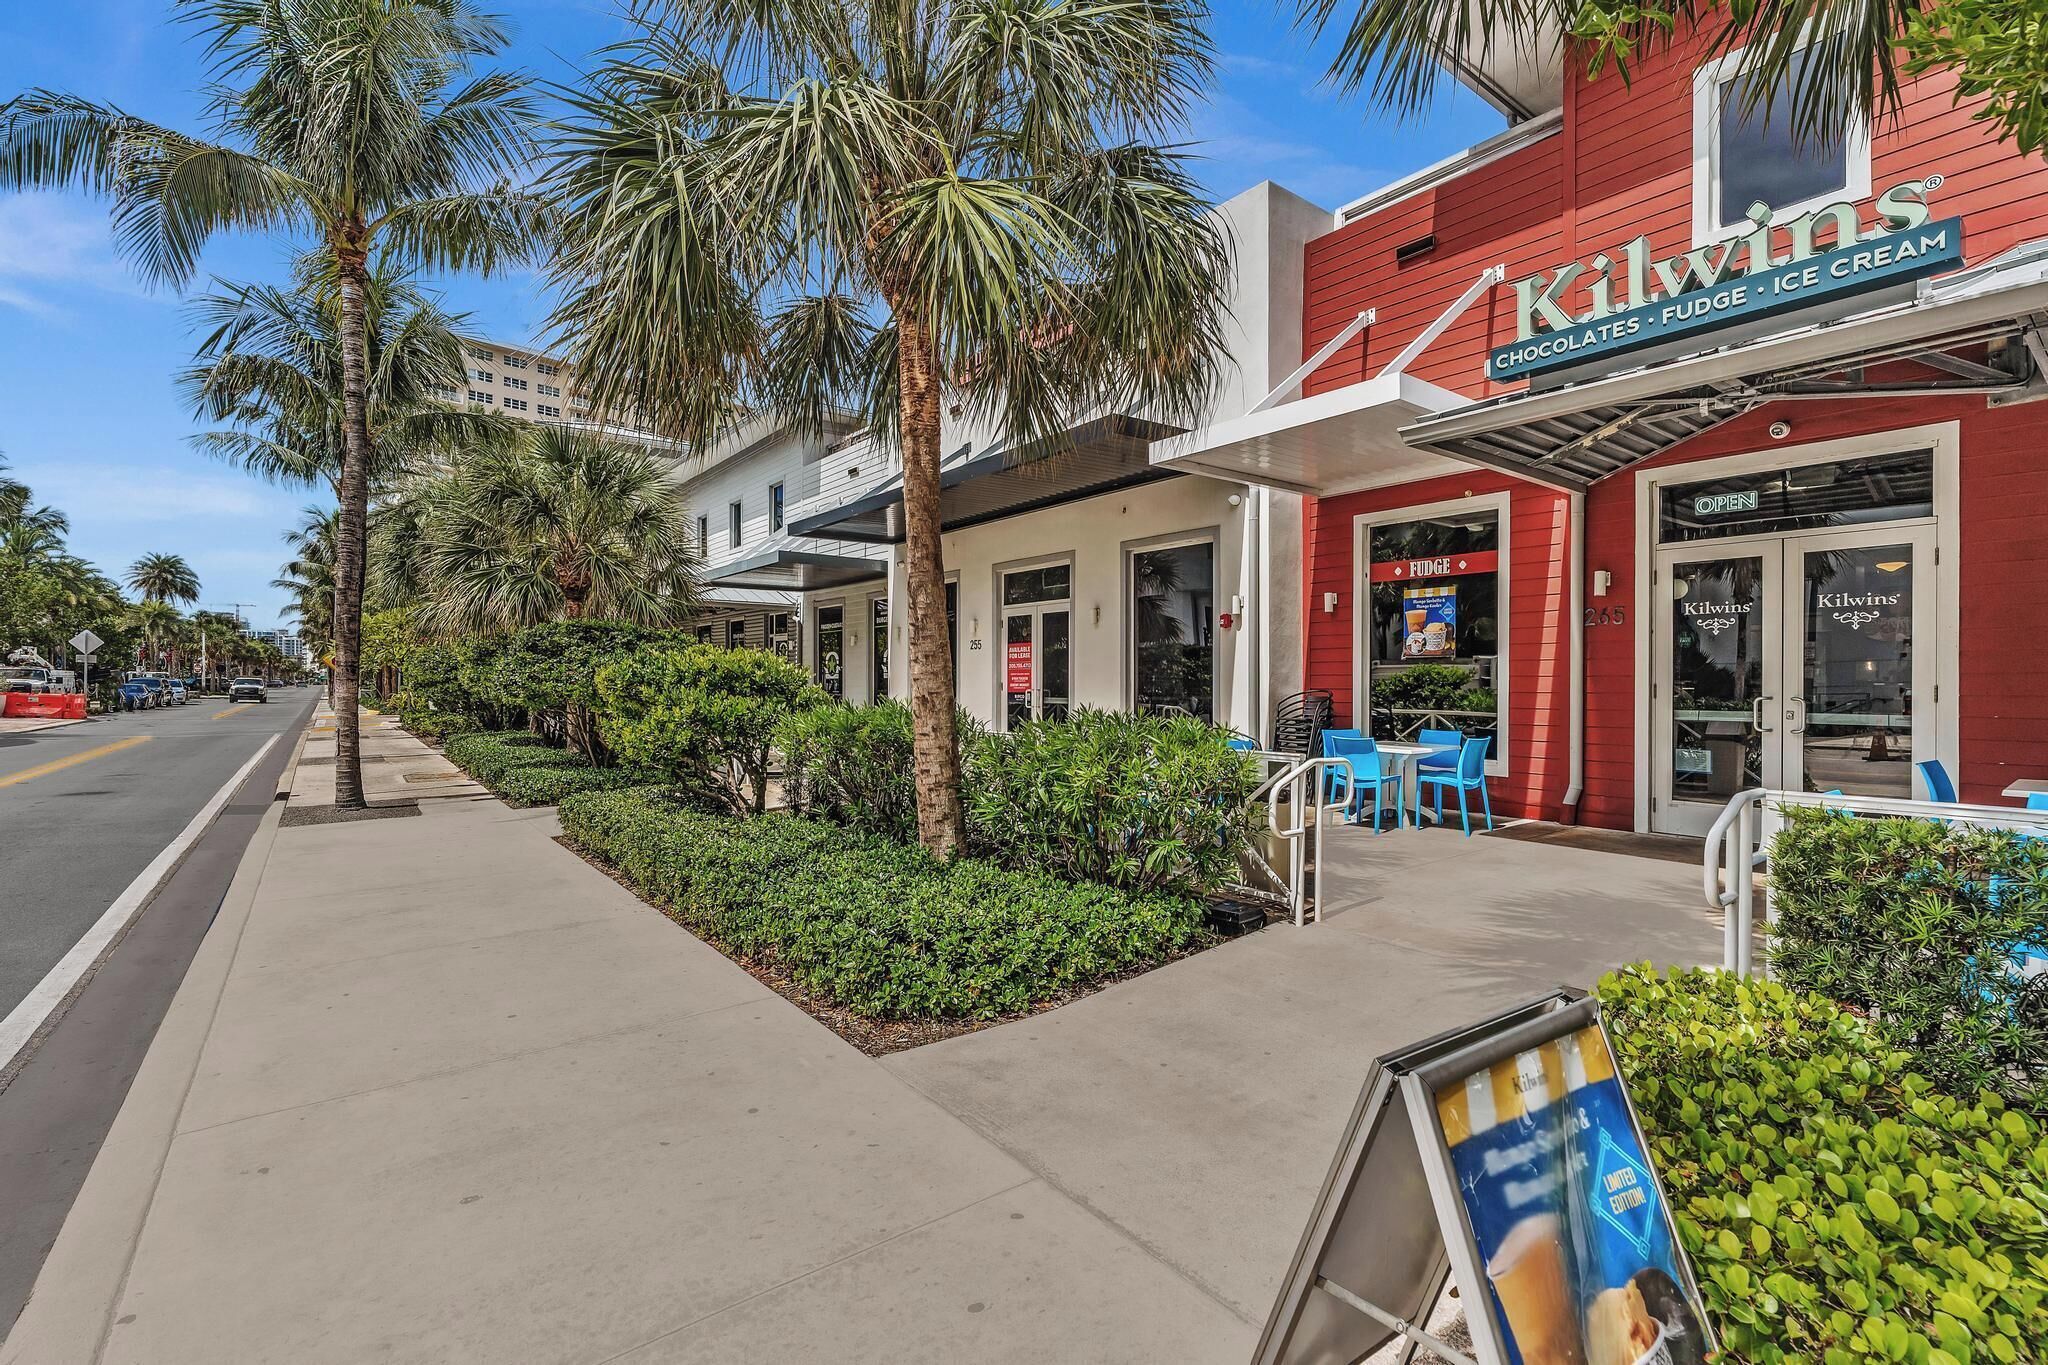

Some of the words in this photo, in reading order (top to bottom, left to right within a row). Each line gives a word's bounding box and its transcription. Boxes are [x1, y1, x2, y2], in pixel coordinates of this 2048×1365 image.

[1496, 317, 1640, 371] CHOCOLATES
[1662, 286, 1748, 326] FUDGE
[1773, 265, 1820, 296] ICE
[1830, 229, 1947, 279] CREAM
[1696, 492, 1756, 513] OPEN
[1409, 558, 1450, 577] FUDGE
[1584, 606, 1624, 627] 265
[970, 639, 982, 650] 255
[1603, 1166, 1638, 1194] LIMITED
[1609, 1185, 1648, 1215] EDITION!
